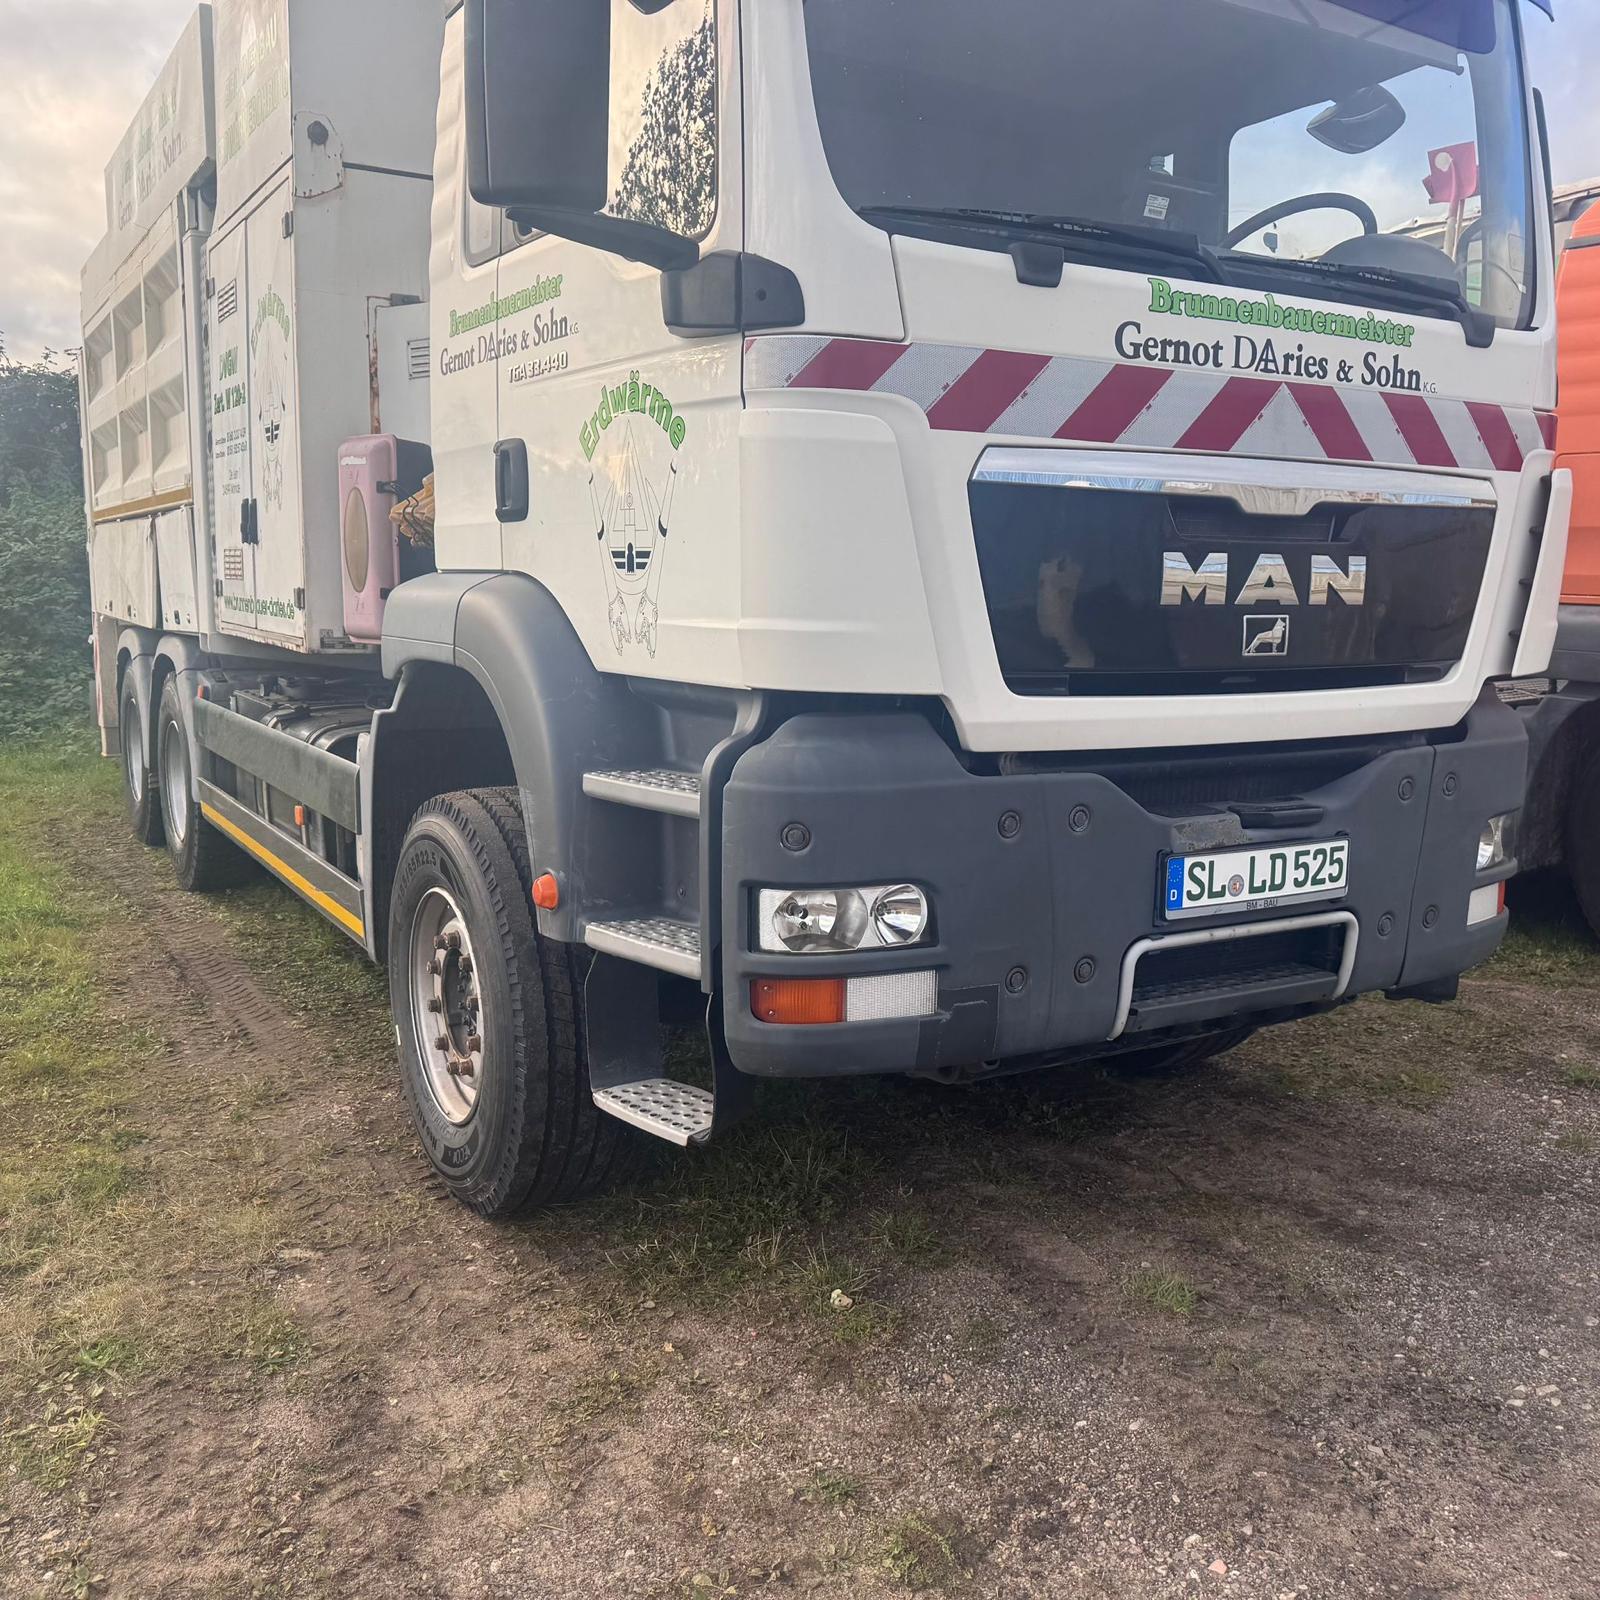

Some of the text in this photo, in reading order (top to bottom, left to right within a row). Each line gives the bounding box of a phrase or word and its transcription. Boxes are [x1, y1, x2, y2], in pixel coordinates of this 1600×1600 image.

[449, 273, 563, 337] Brunnenbauermeister
[1147, 277, 1415, 347] Brunnenbauermeister
[440, 343, 475, 376] Gernot
[520, 334, 530, 350] &
[533, 307, 569, 345] Sohn
[1114, 321, 1224, 368] Gernot
[1335, 359, 1355, 383] &
[1361, 351, 1422, 392] Sohn
[507, 363, 527, 384] TGA
[578, 370, 687, 463] Erdwärme
[1160, 552, 1367, 605] MAN
[1170, 889, 1178, 901] D
[1186, 845, 1345, 902] SL LD 525
[1246, 901, 1258, 910] BM
[1263, 898, 1278, 908] BAU
